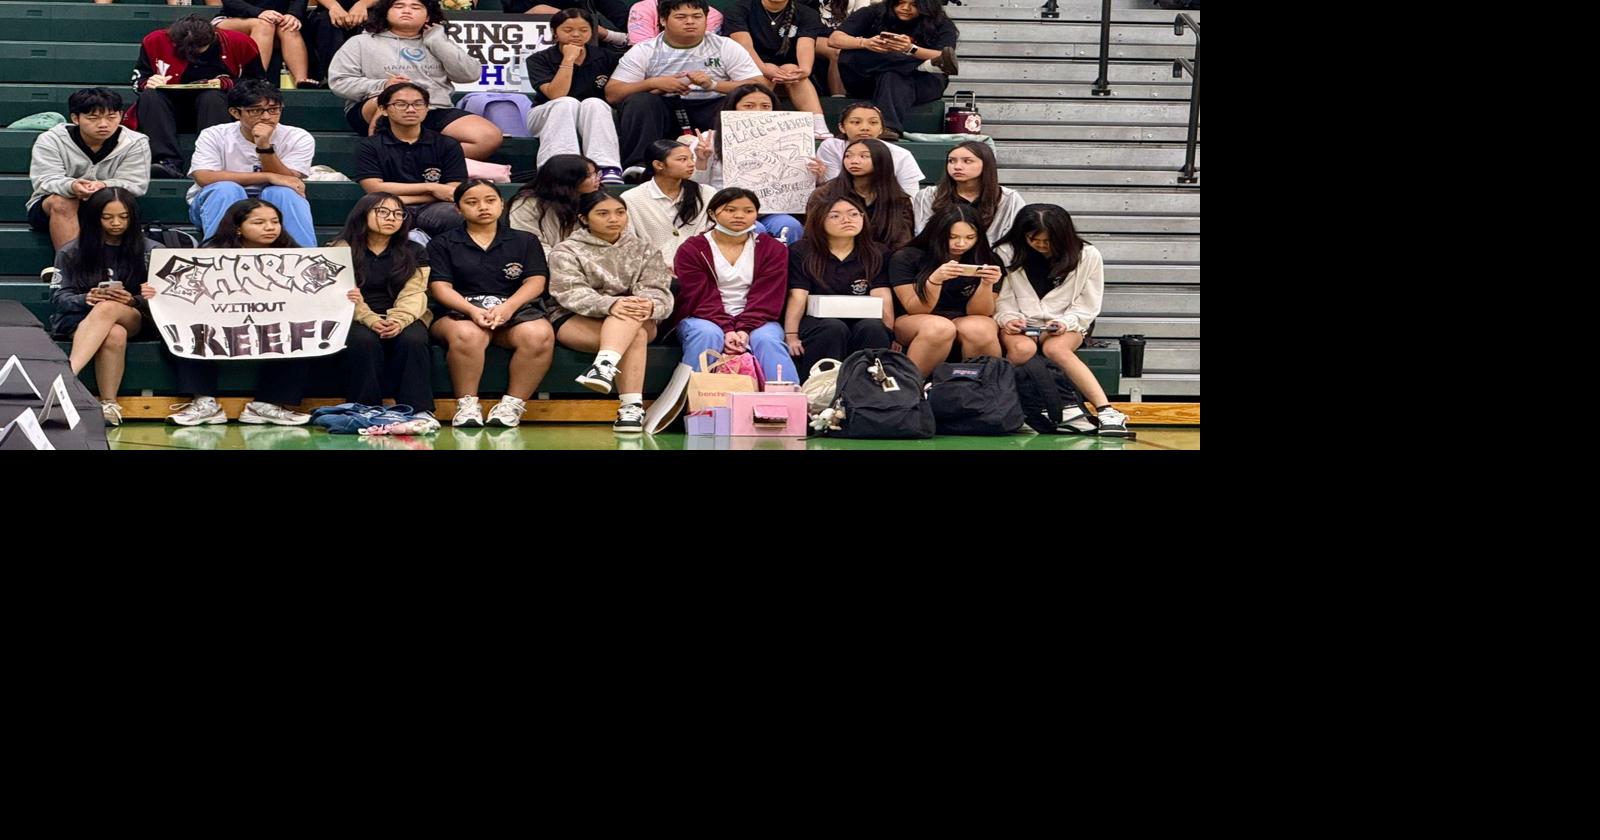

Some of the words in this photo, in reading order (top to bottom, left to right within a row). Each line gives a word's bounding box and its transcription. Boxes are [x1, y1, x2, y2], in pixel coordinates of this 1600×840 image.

[446, 24, 523, 44] RING
[536, 25, 557, 44] U
[211, 302, 286, 313] WITHOUT
[243, 314, 254, 324] A
